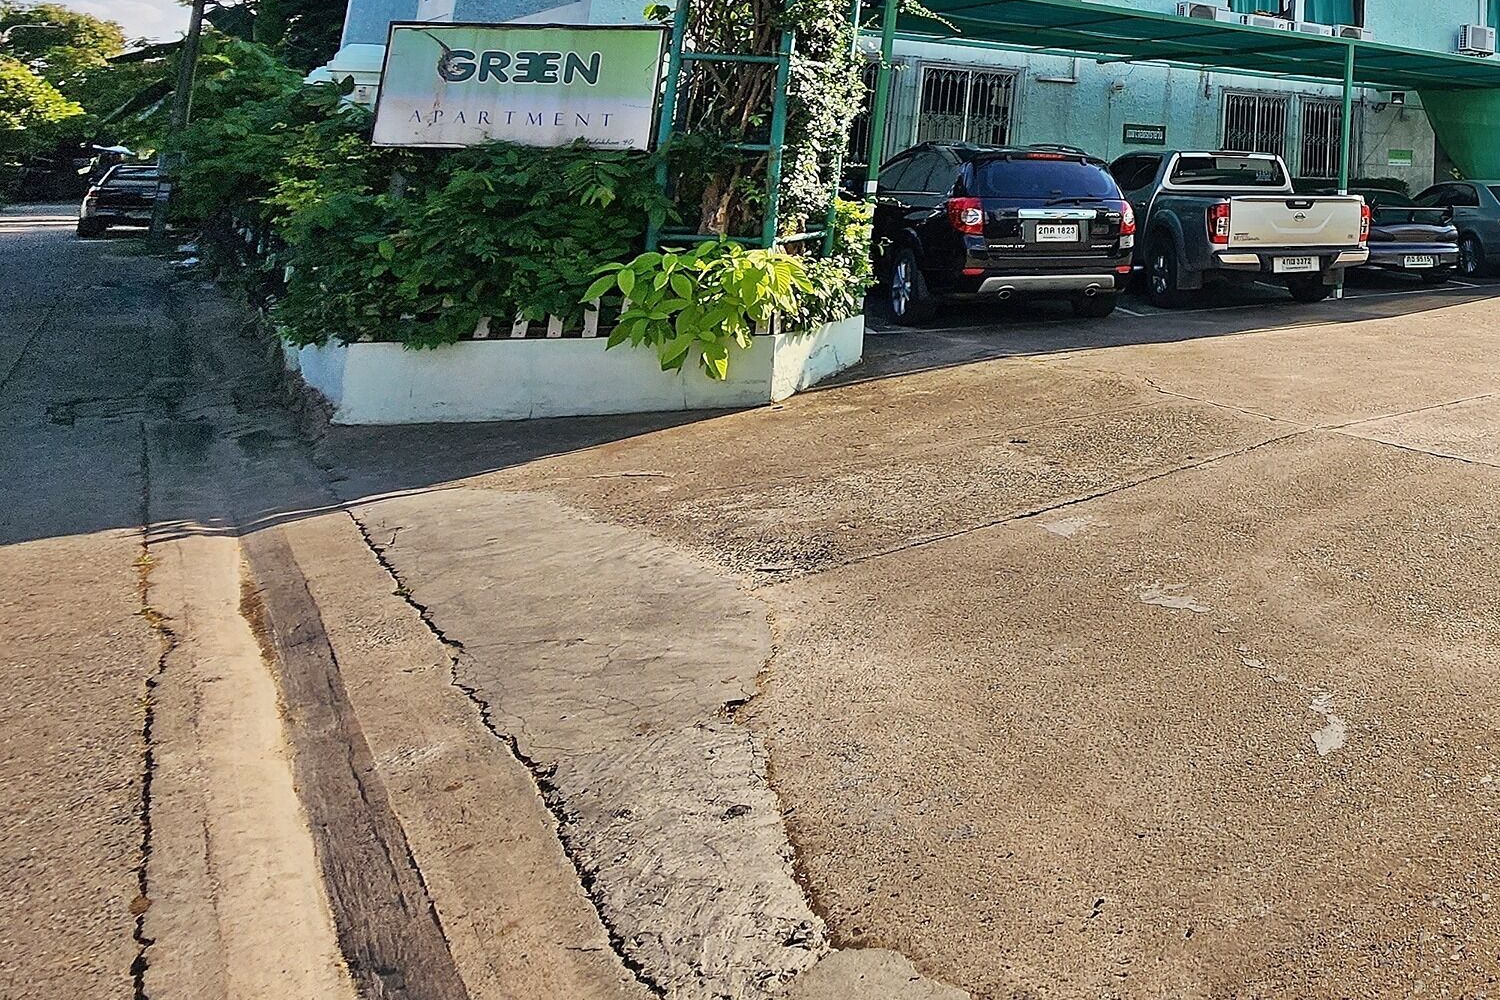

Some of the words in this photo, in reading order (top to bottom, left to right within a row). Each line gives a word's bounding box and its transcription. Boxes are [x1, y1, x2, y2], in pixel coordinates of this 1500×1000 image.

[446, 50, 601, 84] GREEN
[409, 110, 614, 127] APARTMENT
[1057, 226, 1075, 234] 1823
